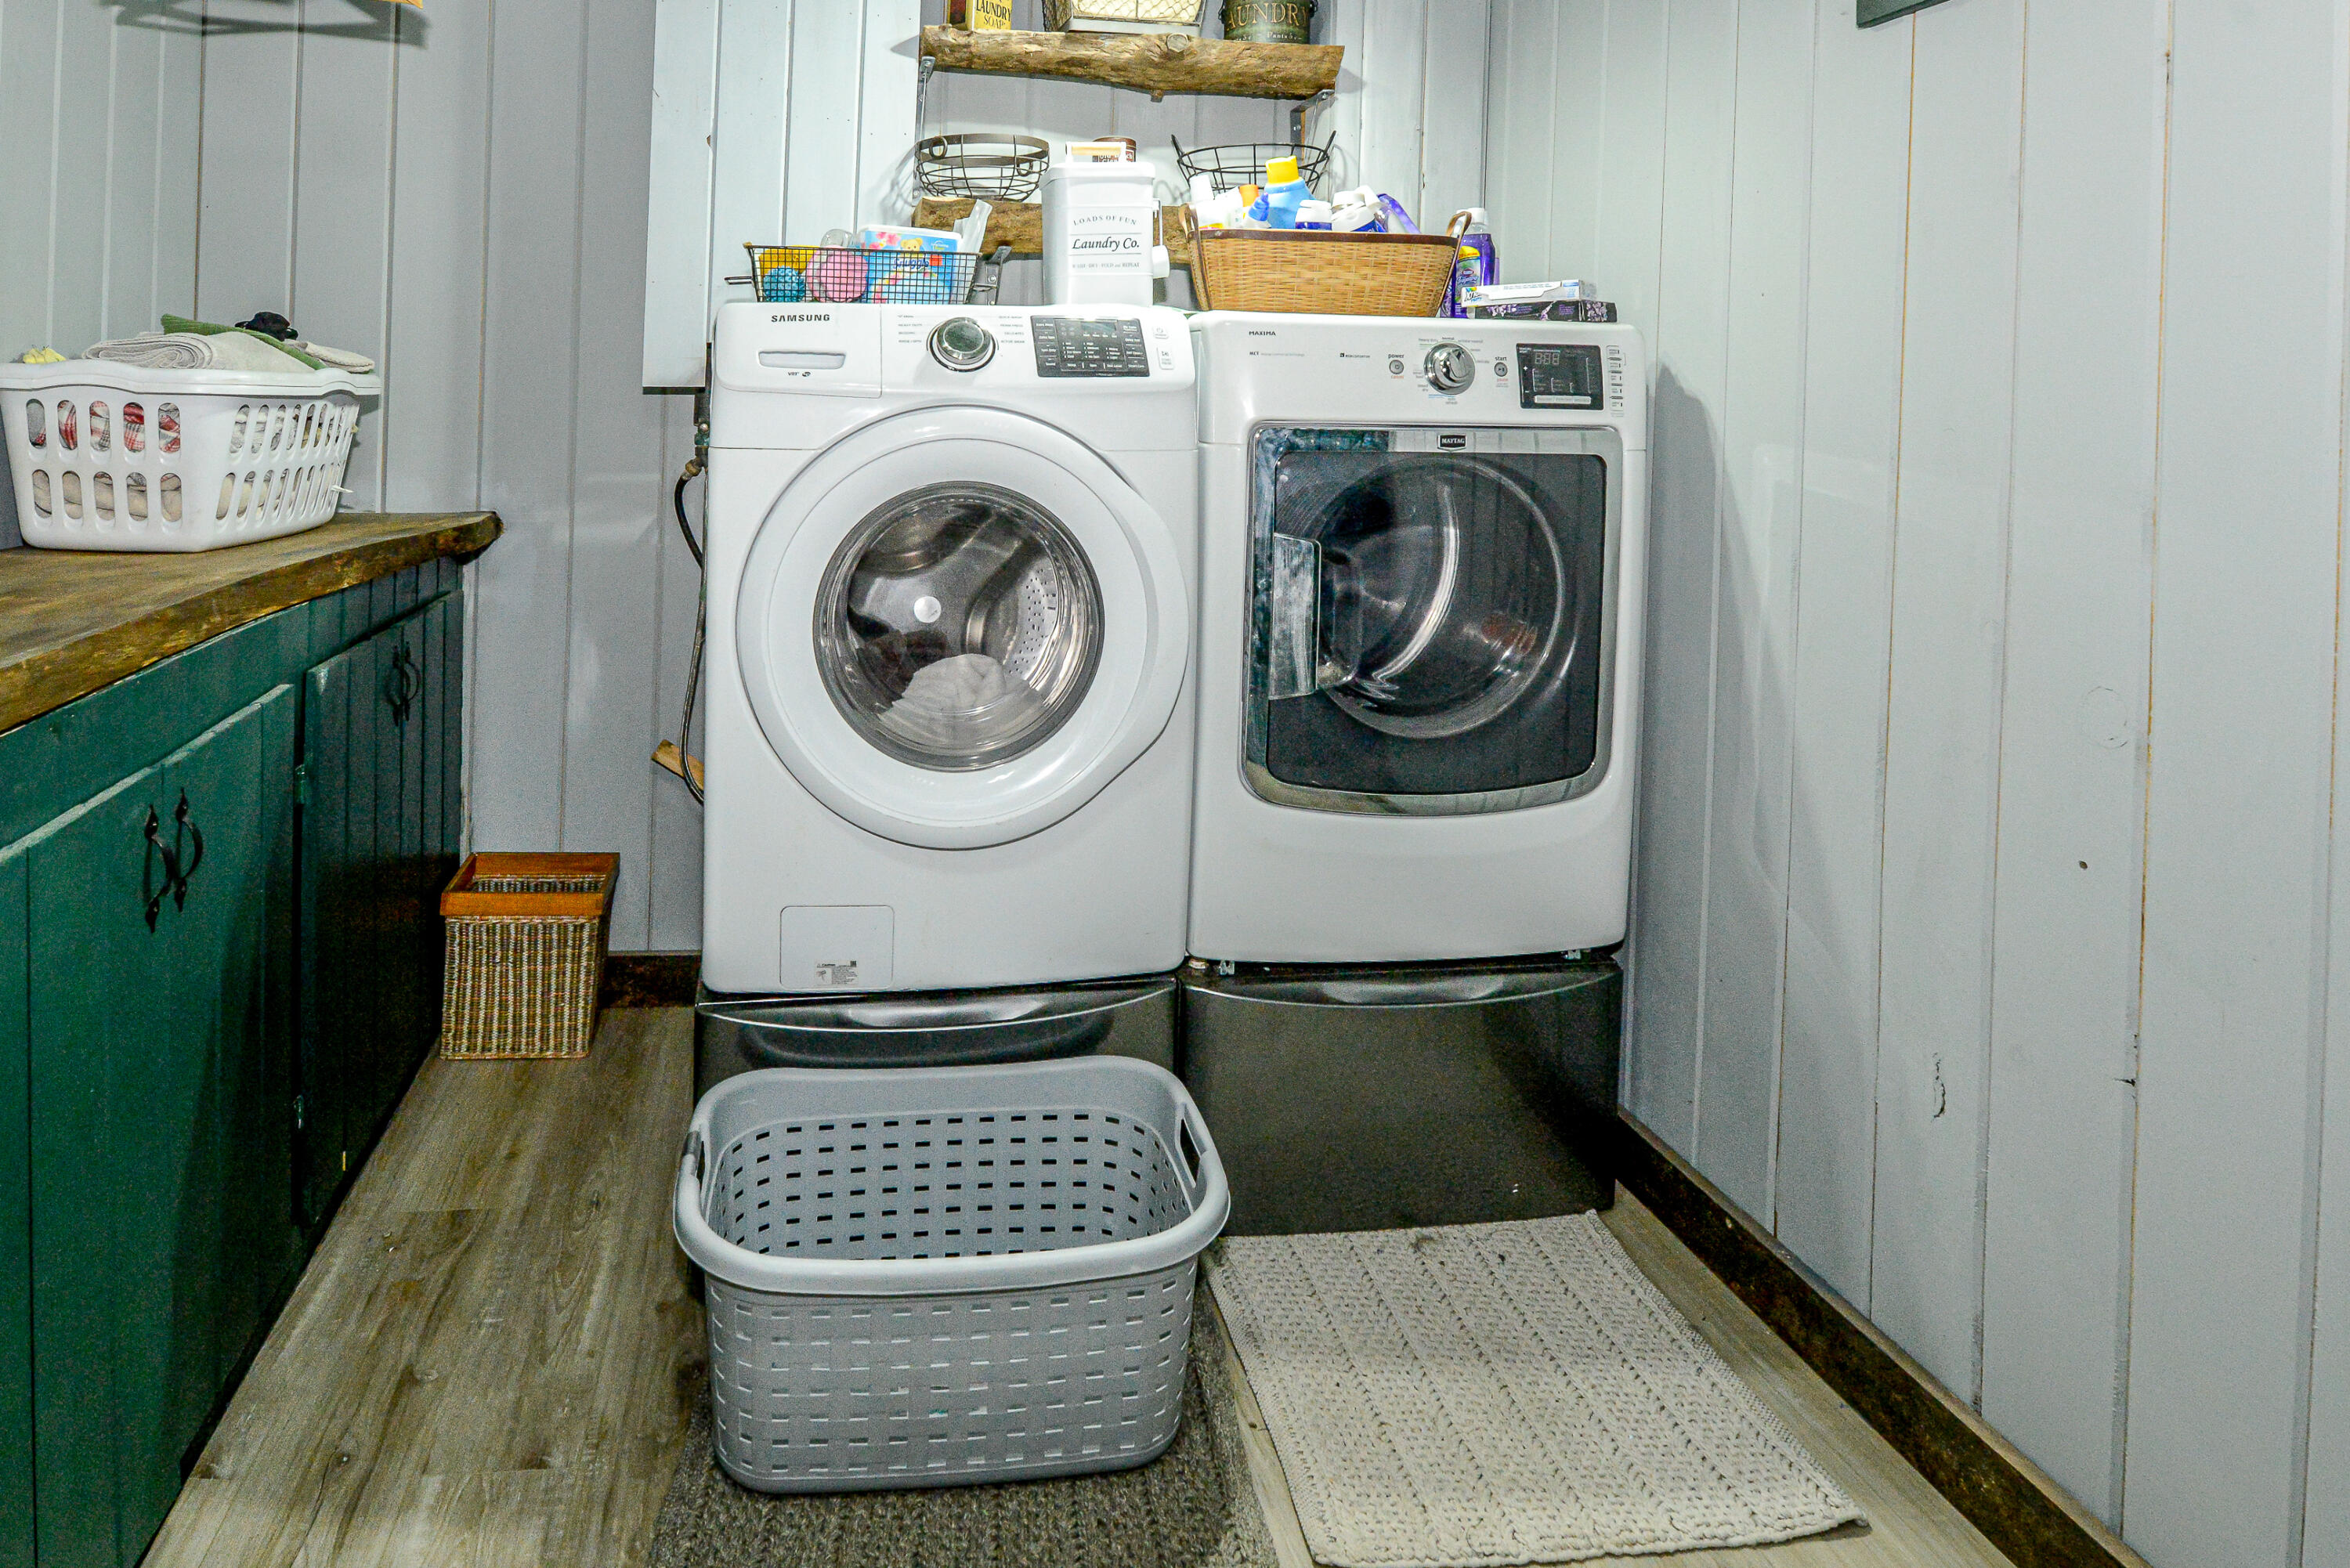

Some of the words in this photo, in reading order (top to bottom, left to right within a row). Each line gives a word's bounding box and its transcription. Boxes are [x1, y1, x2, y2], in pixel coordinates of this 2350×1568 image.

[976, 0, 1011, 21] LAUNDRY
[1227, 2, 1309, 31] AUNDRY
[1073, 215, 1104, 226] LOADS
[1119, 216, 1137, 226] FUN
[1072, 237, 1120, 252] Laundry
[1123, 237, 1140, 249] Co.
[771, 313, 830, 323] SAMSUNG
